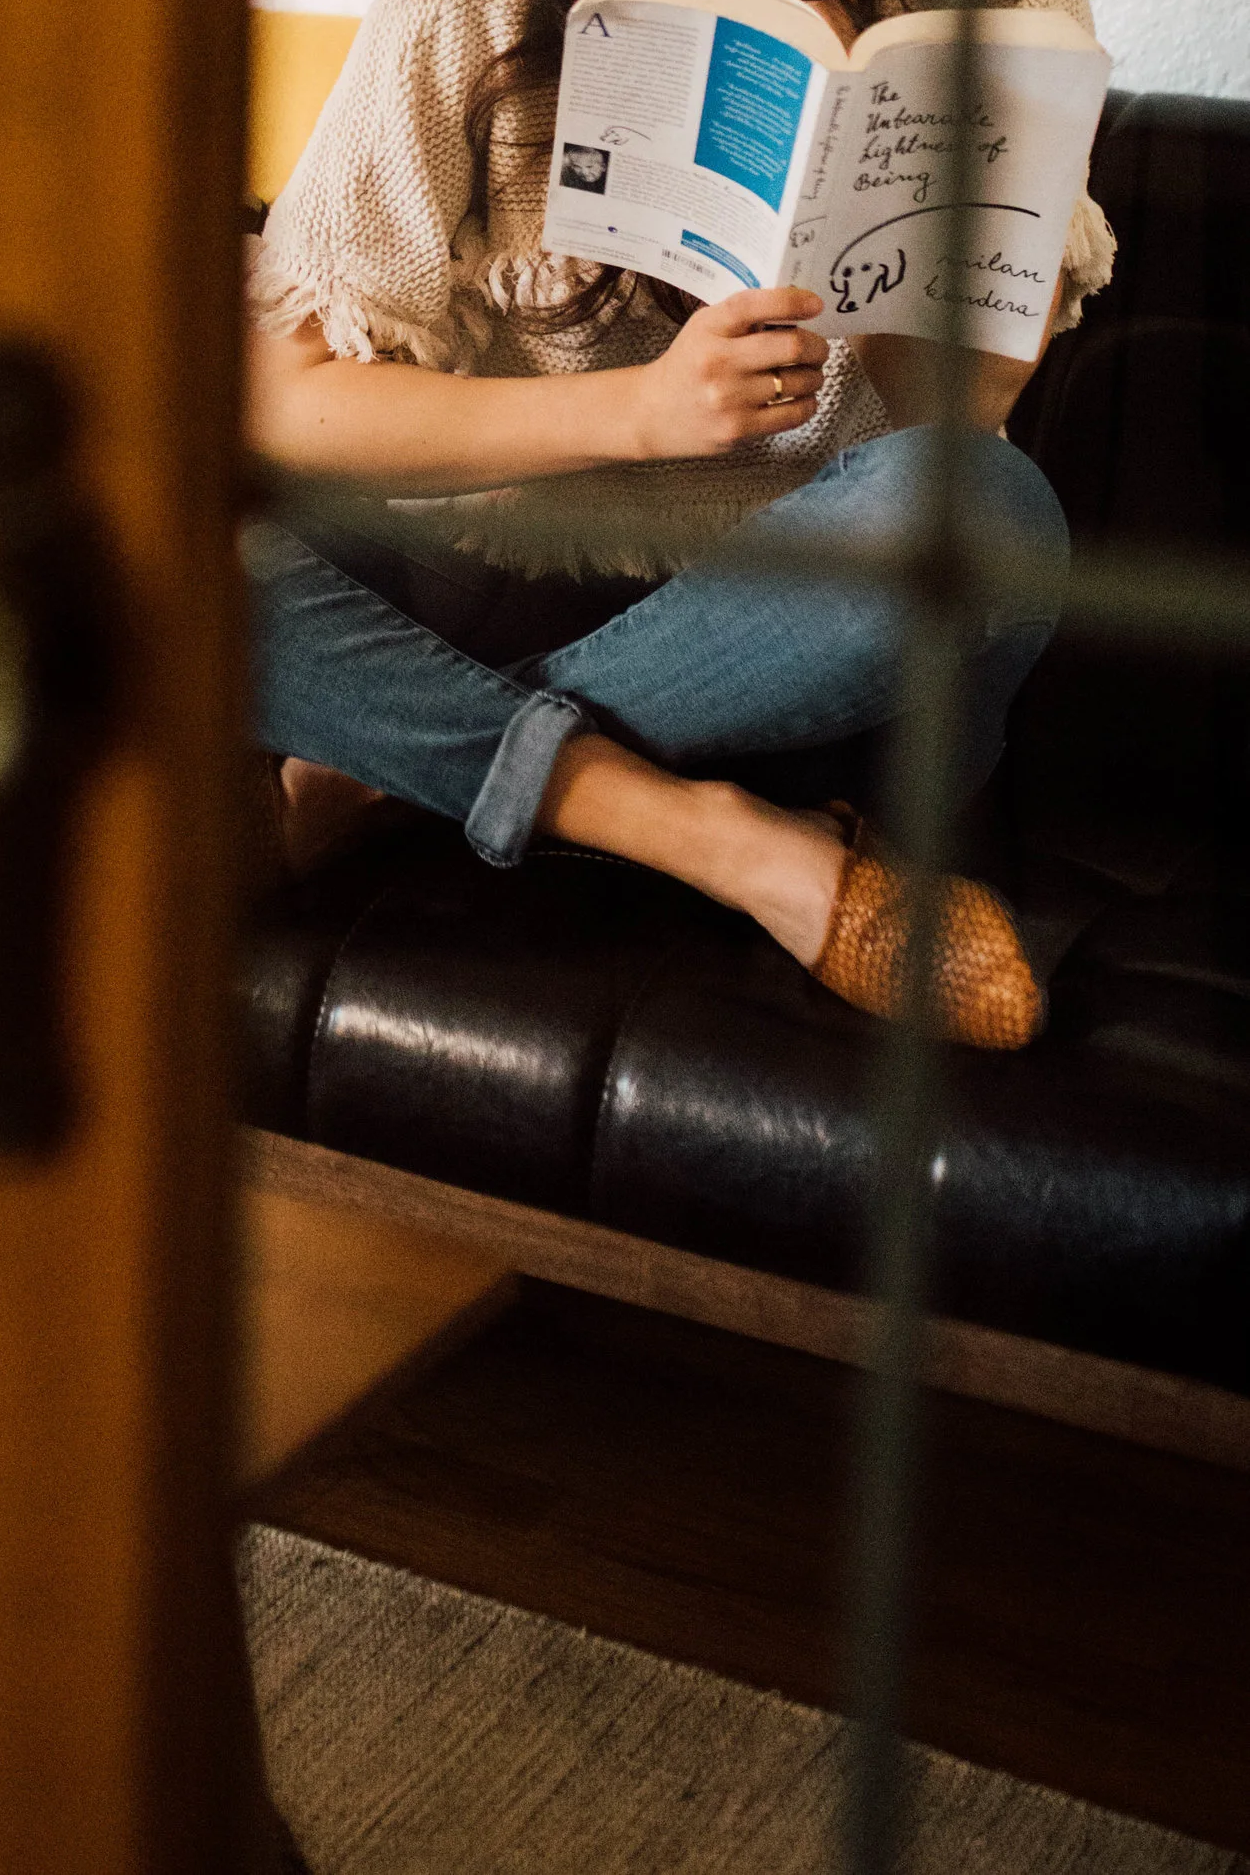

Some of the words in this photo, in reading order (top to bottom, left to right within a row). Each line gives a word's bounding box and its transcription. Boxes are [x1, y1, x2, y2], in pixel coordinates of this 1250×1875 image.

[870, 81, 901, 105] The
[866, 104, 994, 134] Unbearale
[858, 133, 962, 170] Lightne
[978, 136, 1008, 164] of
[853, 171, 937, 203] Being
[923, 274, 1040, 317] kndera
